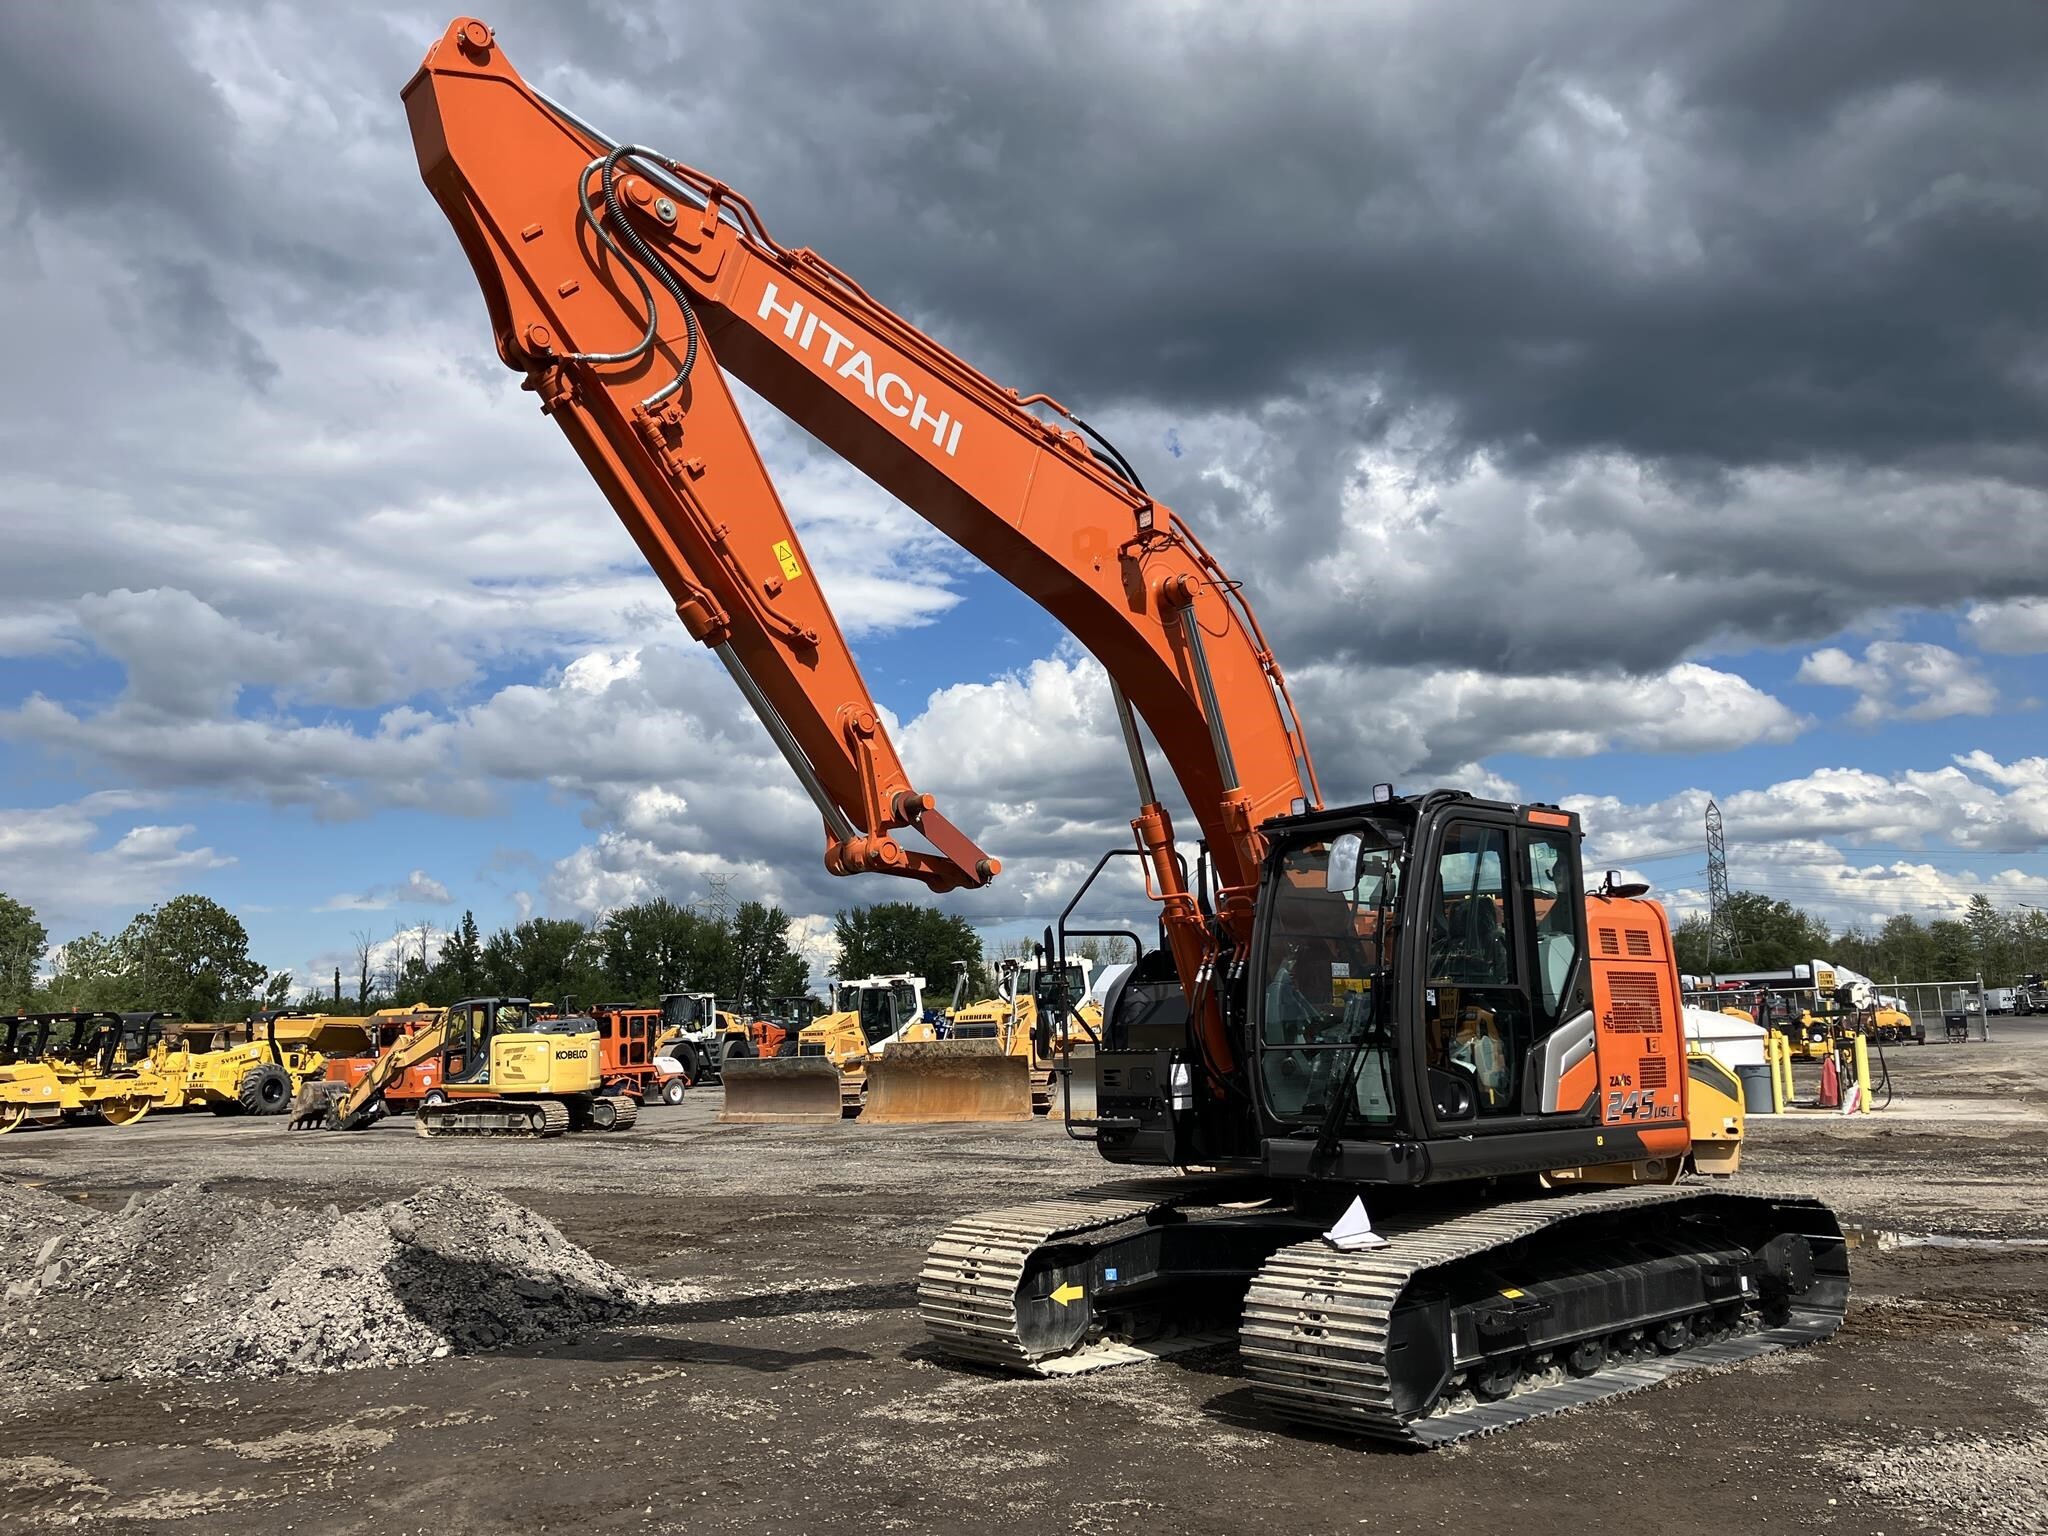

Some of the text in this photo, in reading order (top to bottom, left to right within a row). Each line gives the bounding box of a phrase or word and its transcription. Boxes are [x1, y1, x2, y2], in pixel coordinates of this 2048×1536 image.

[757, 282, 963, 457] HITACHI
[555, 1050, 588, 1060] KOBELCO
[1606, 1090, 1655, 1122] 245
